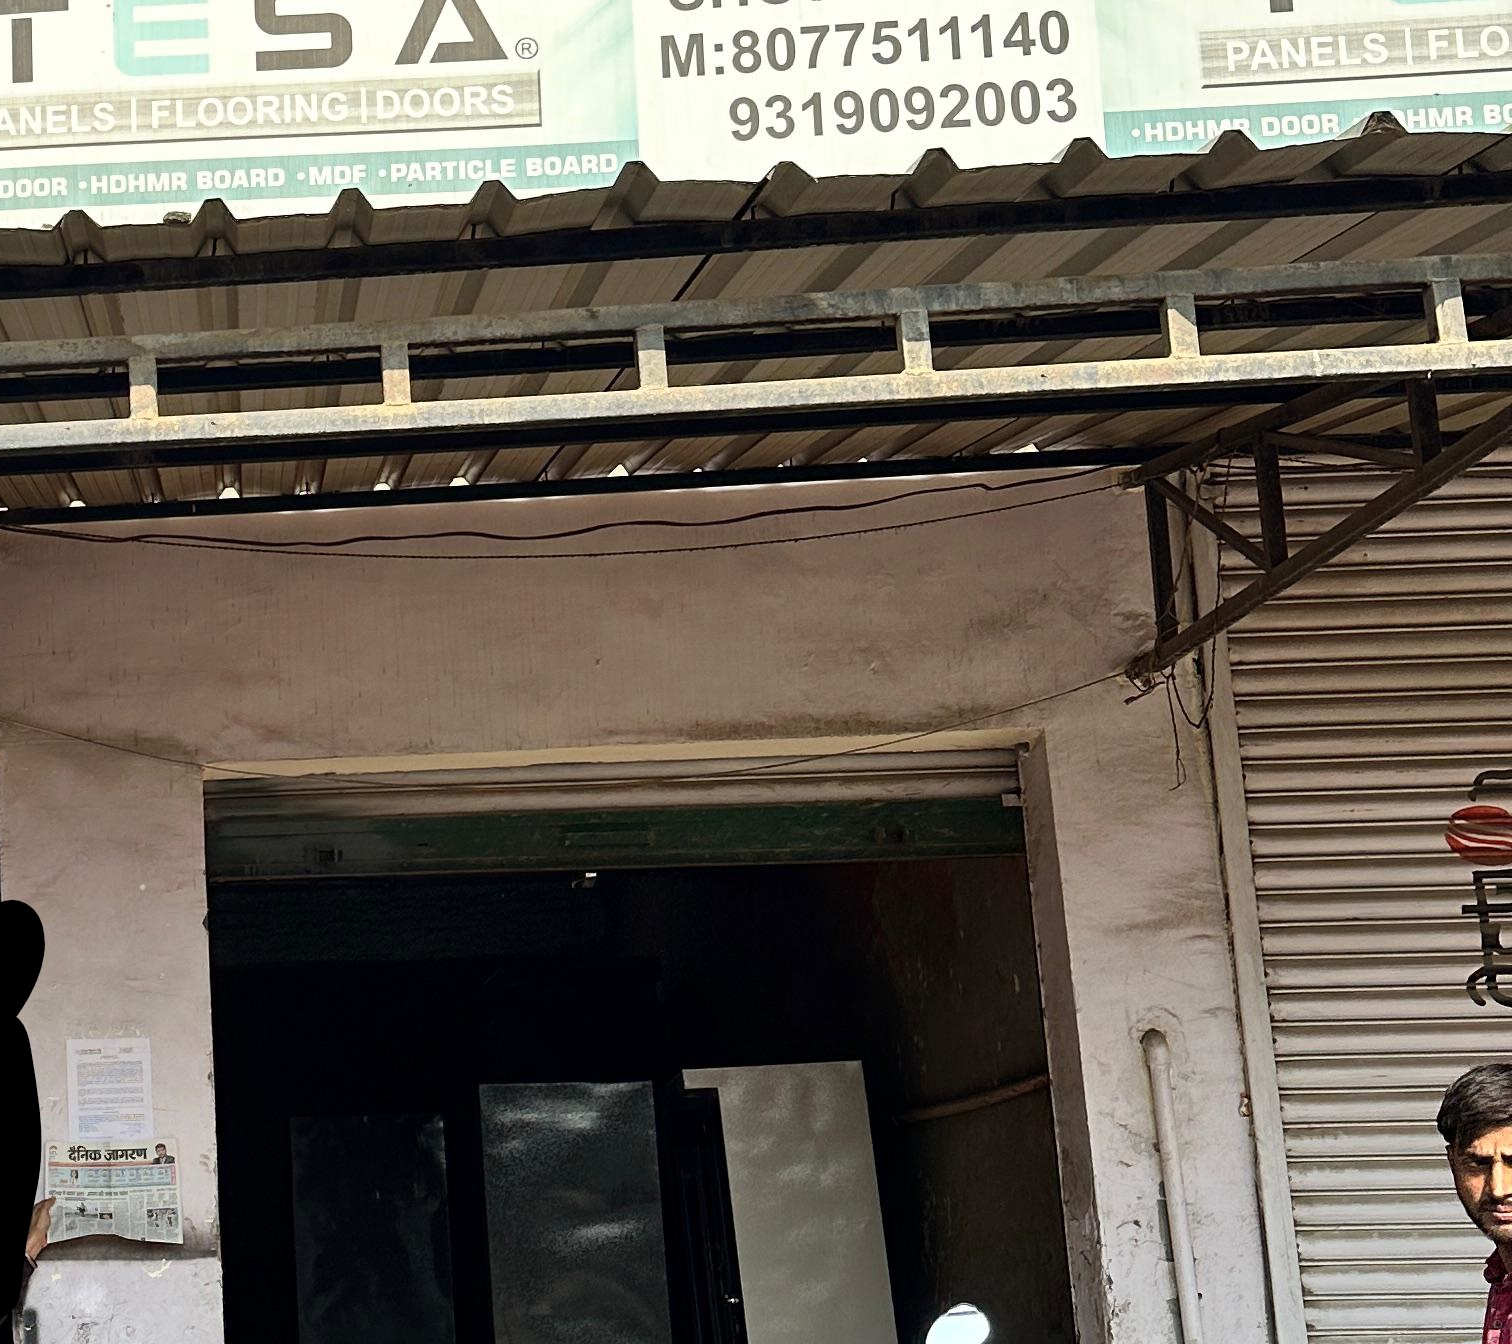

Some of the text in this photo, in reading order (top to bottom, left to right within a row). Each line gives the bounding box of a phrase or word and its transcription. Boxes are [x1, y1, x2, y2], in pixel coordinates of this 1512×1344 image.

[660, 9, 1071, 79] M:8077511140
[1226, 32, 1389, 72] PANELS
[150, 92, 349, 130] FLOORING
[376, 85, 515, 120] DOORS
[728, 77, 1079, 143] 9319092003
[1261, 113, 1340, 137] DOOR
[89, 171, 188, 196] HDHMR
[196, 166, 286, 190] BOARD
[307, 164, 368, 186] MDF
[389, 158, 518, 183] PARTICLE
[525, 153, 619, 177] BOARD
[67, 1145, 147, 1162] दैनिक जागरण
